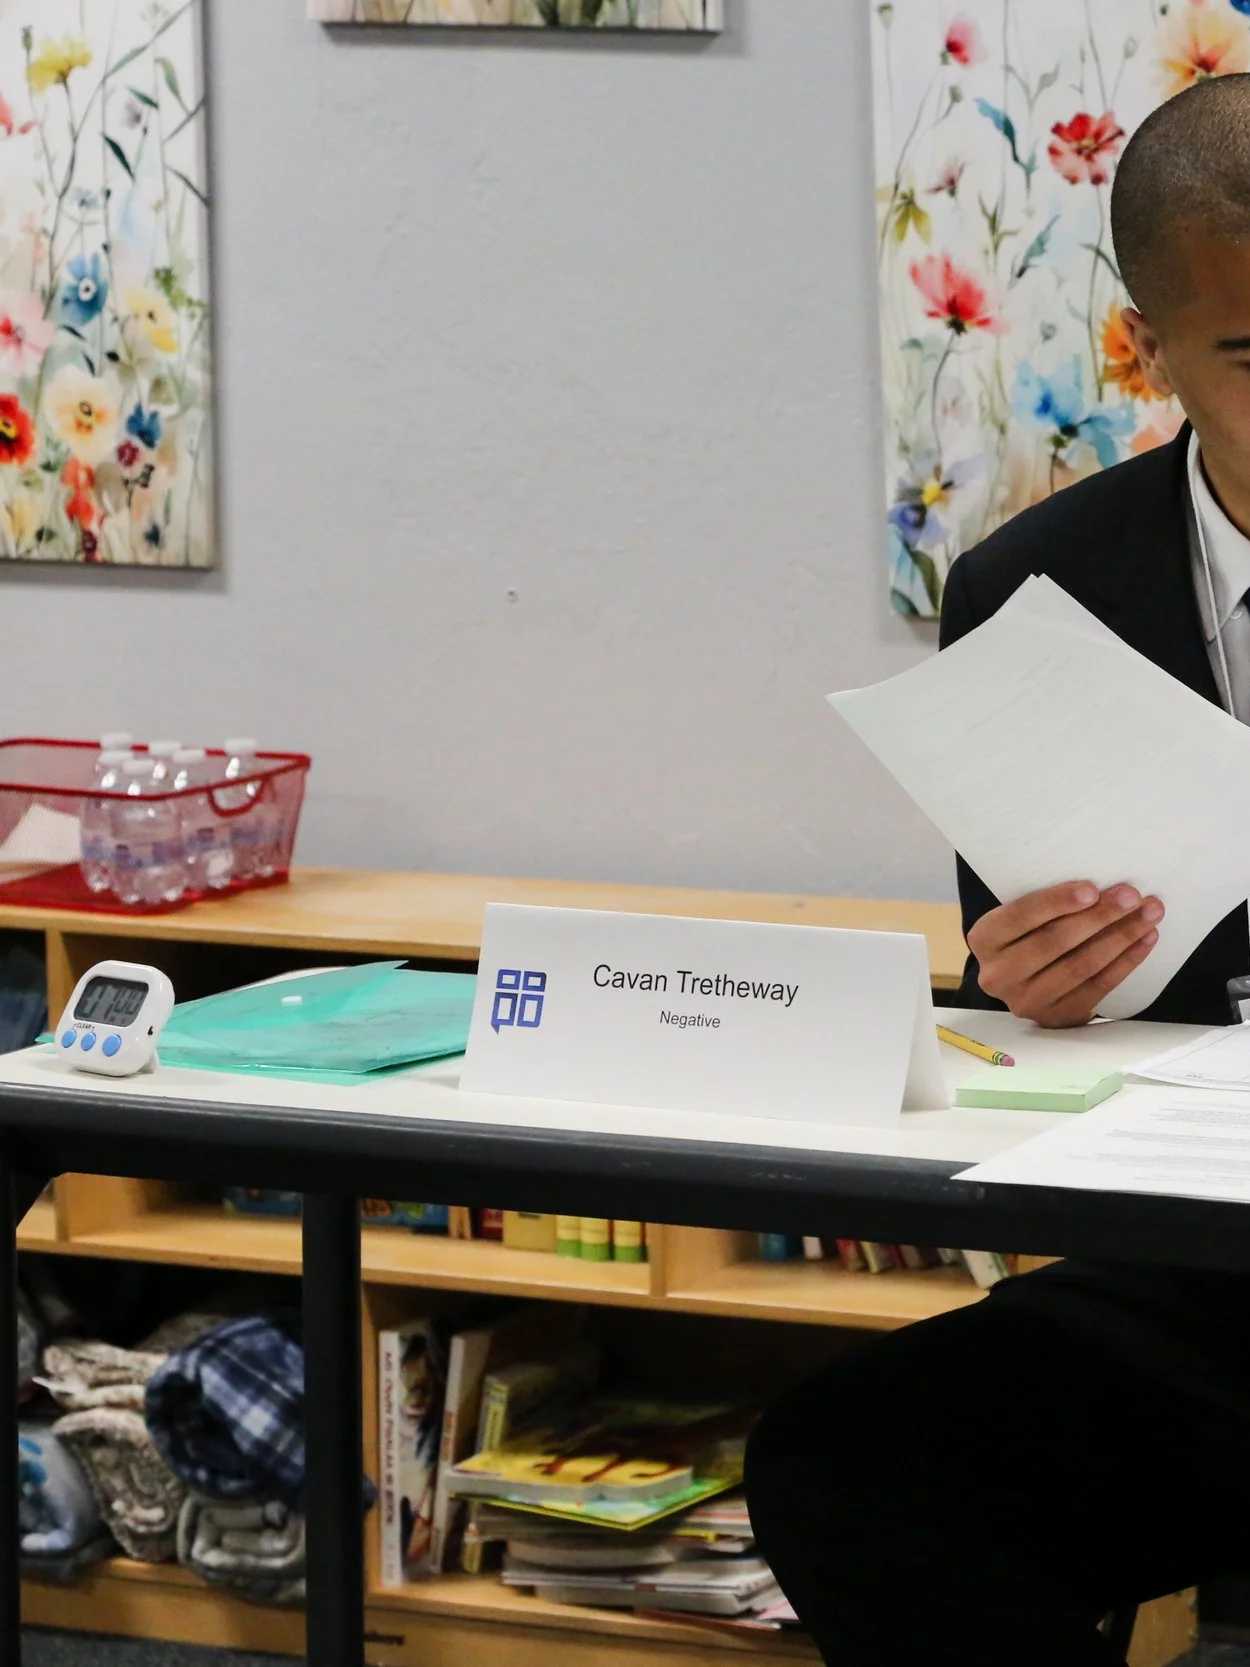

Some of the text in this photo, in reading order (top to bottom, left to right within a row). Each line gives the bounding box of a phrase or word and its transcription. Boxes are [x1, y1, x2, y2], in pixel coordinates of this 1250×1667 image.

[593, 963, 800, 1008] Cavan Tretheway
[659, 1010, 721, 1030] Negative
